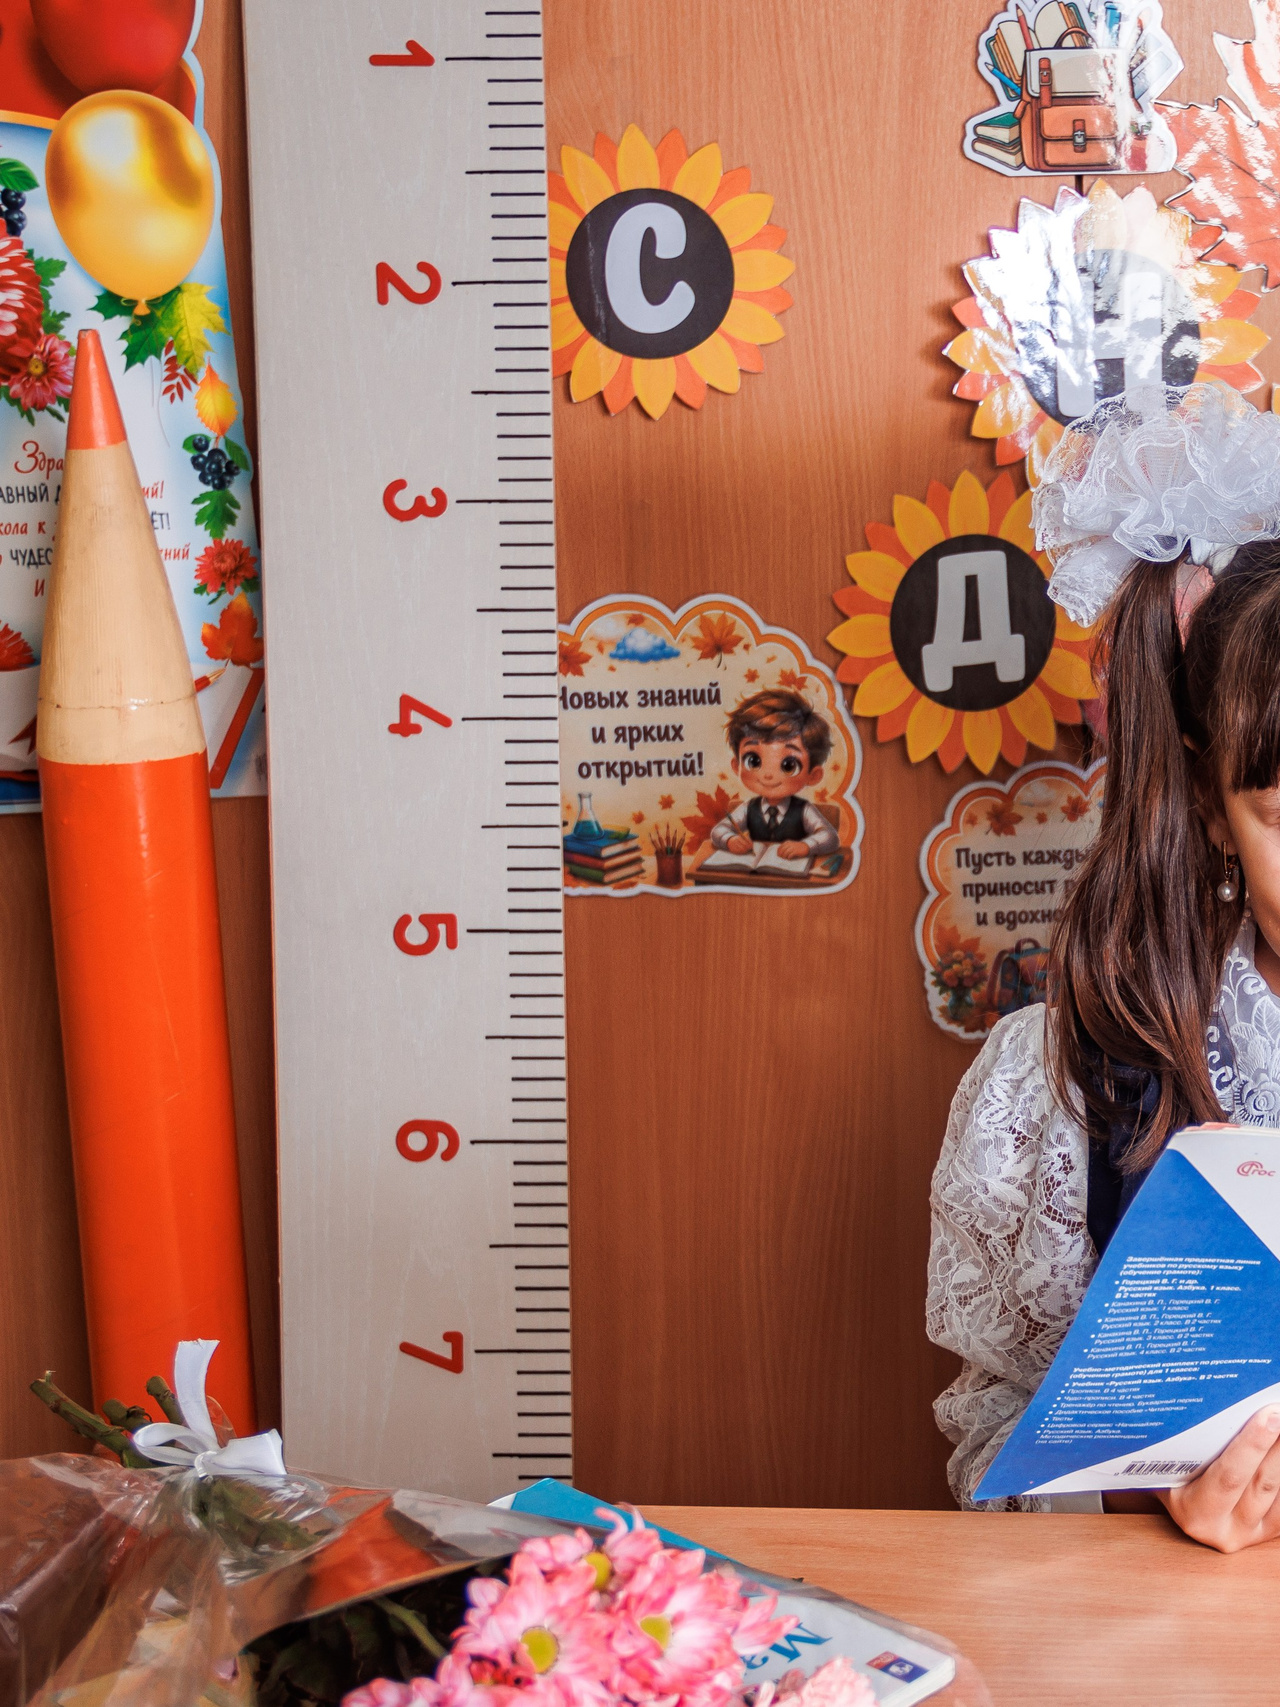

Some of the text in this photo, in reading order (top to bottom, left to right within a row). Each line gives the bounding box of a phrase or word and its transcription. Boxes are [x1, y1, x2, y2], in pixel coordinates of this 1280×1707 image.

[369, 40, 435, 67] 1
[375, 261, 443, 306] 2
[604, 201, 696, 335] С
[14, 440, 65, 480] Здра
[0, 482, 49, 504] АВНЫЙ
[382, 478, 449, 523] 3
[0, 520, 29, 537] кола
[10, 548, 54, 568] ЧУДЕС
[921, 550, 1027, 694] Д
[636, 681, 723, 709] знаний
[388, 693, 454, 739] 4
[591, 723, 686, 751] и ярких
[577, 751, 705, 785] открытий!
[955, 847, 1092, 875] Пусть кажды
[962, 878, 1058, 904] приносит
[393, 911, 459, 957] 5
[976, 908, 1063, 931] и вдохно
[395, 1119, 460, 1163] 6
[399, 1330, 464, 1374] 7
